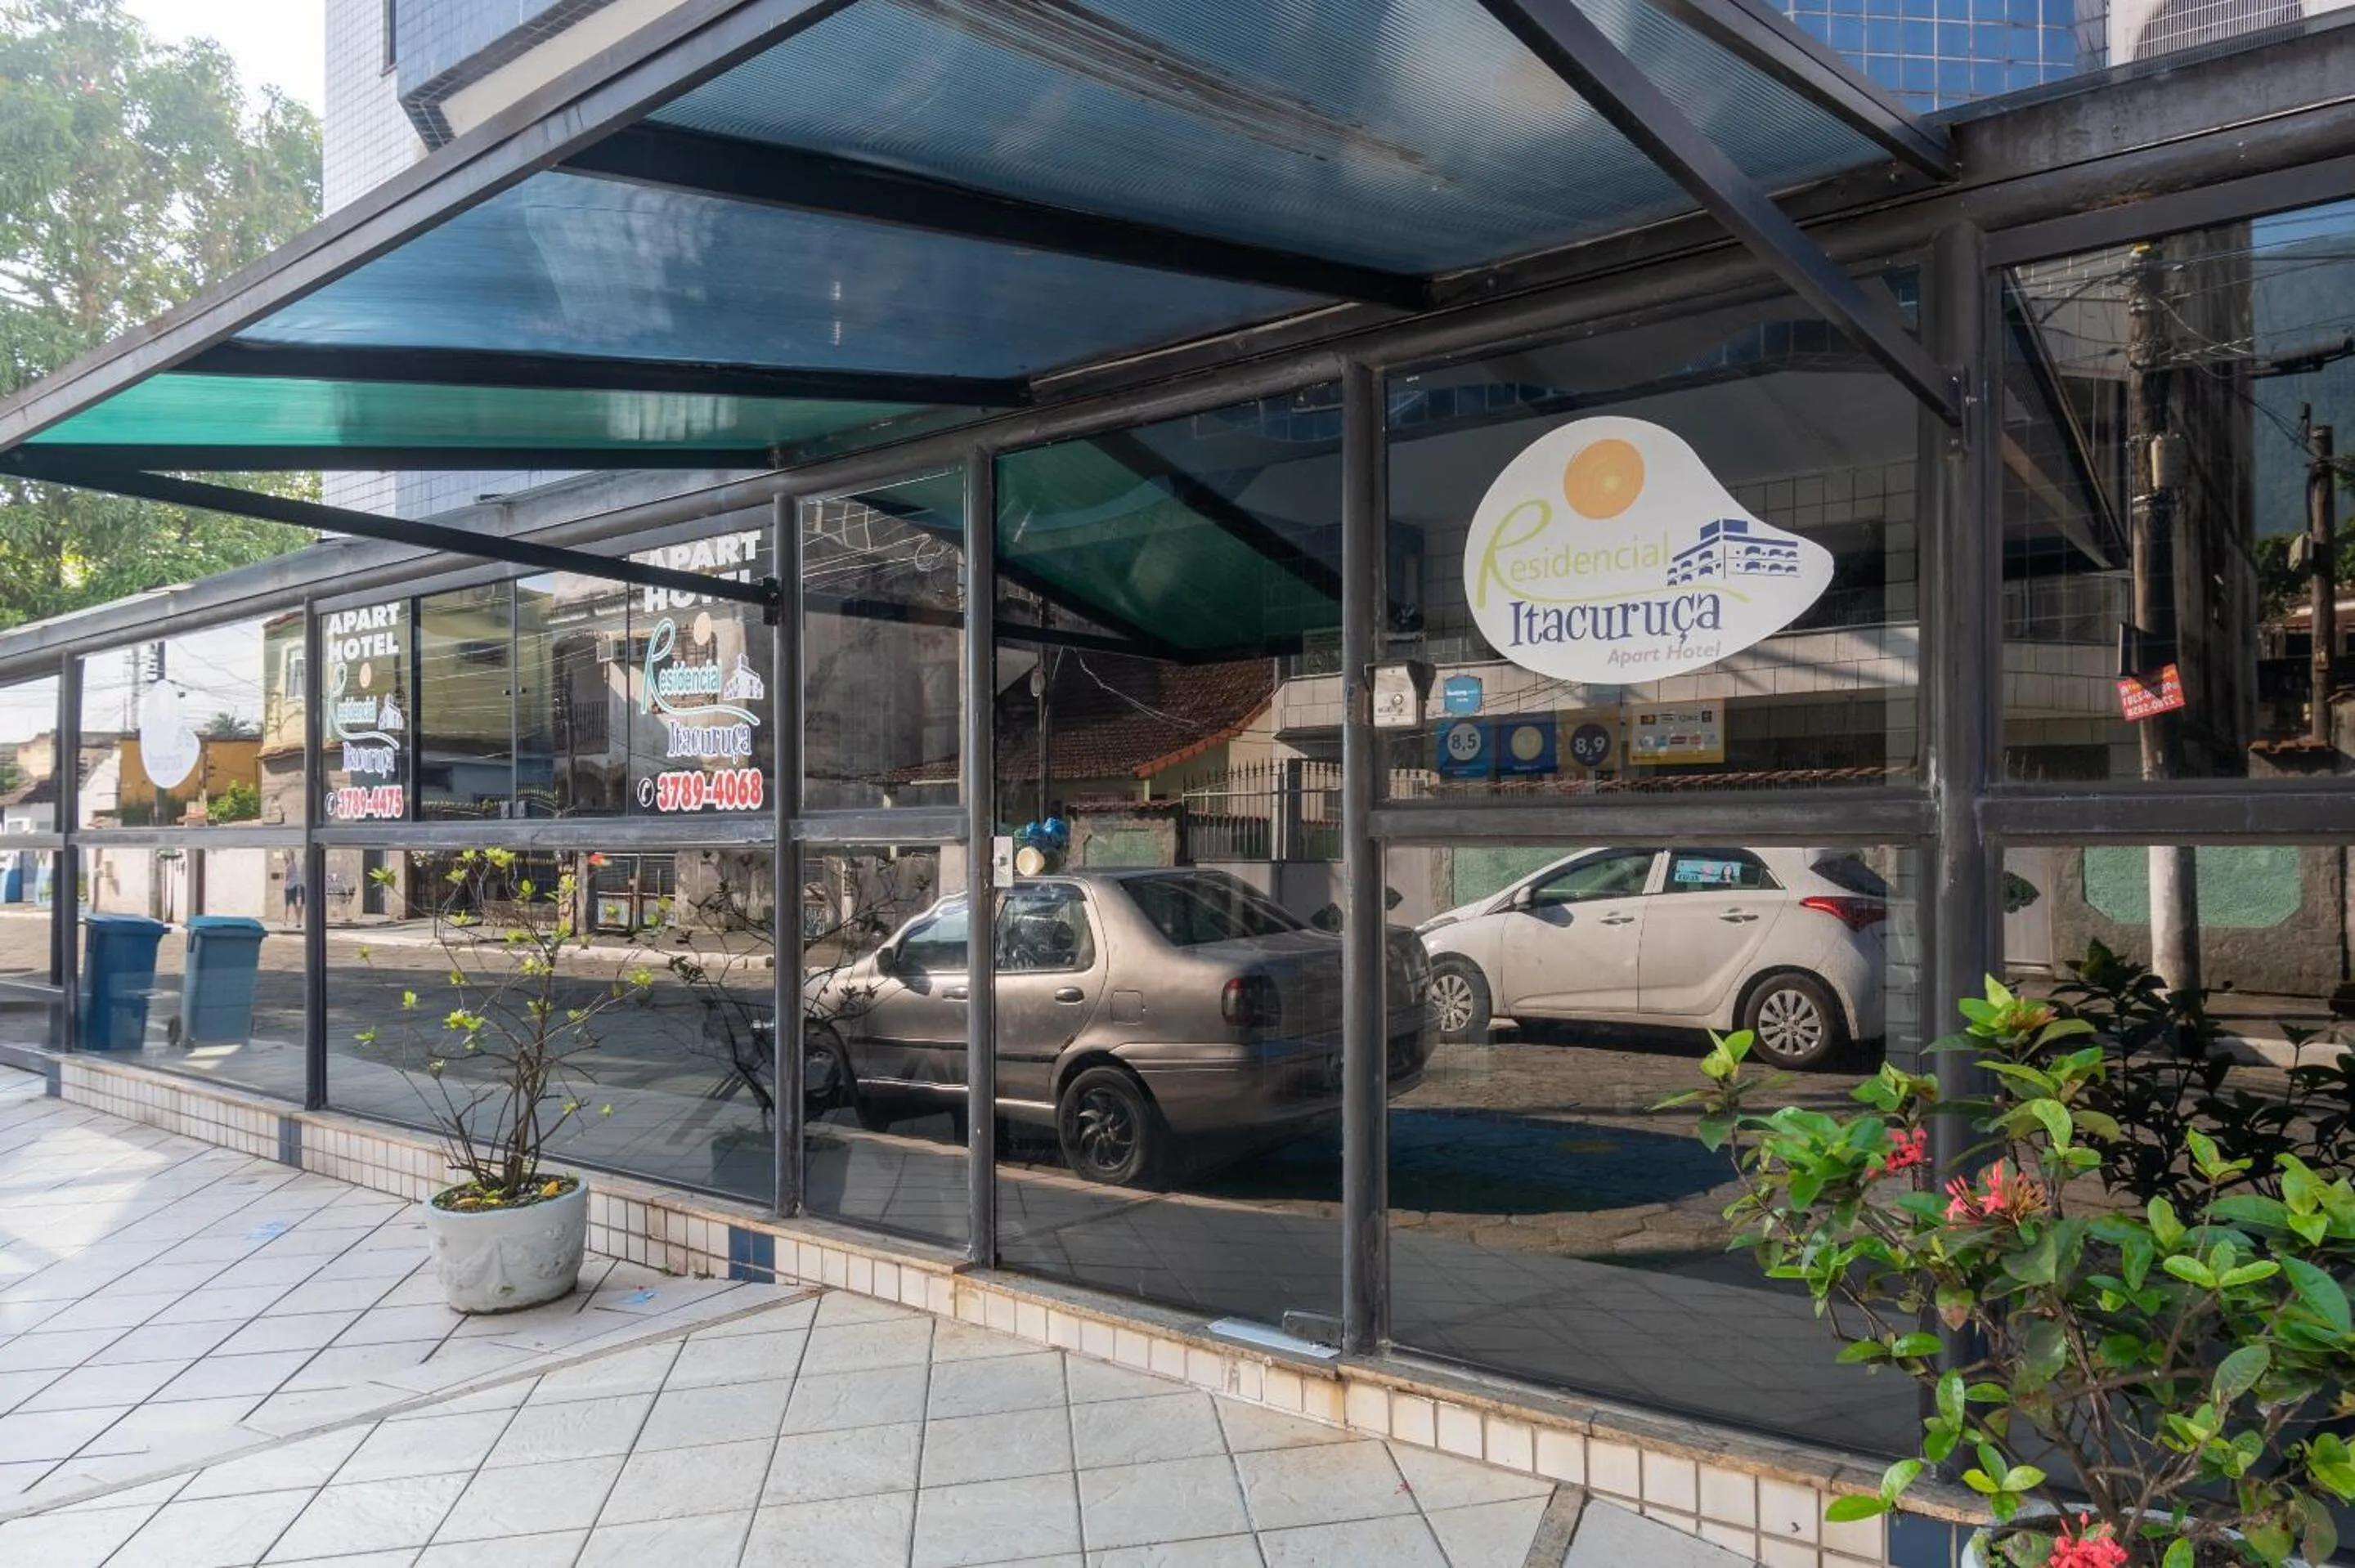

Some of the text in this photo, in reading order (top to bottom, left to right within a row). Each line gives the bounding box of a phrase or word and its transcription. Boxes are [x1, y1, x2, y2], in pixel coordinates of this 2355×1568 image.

[648, 530, 761, 571] APART
[1476, 499, 1671, 607] Residencial
[327, 602, 401, 637] APART
[1507, 592, 1723, 646] Itacuruça
[327, 631, 400, 663] HOTEL
[640, 617, 723, 715] Residencial
[1607, 640, 1722, 668] Apart Hotel
[666, 721, 753, 764] Itacuruça
[1451, 732, 1478, 752] 8,5
[1575, 737, 1606, 756] 8,9
[337, 786, 404, 819] 3789-4475
[657, 768, 764, 812] 3789-4068
